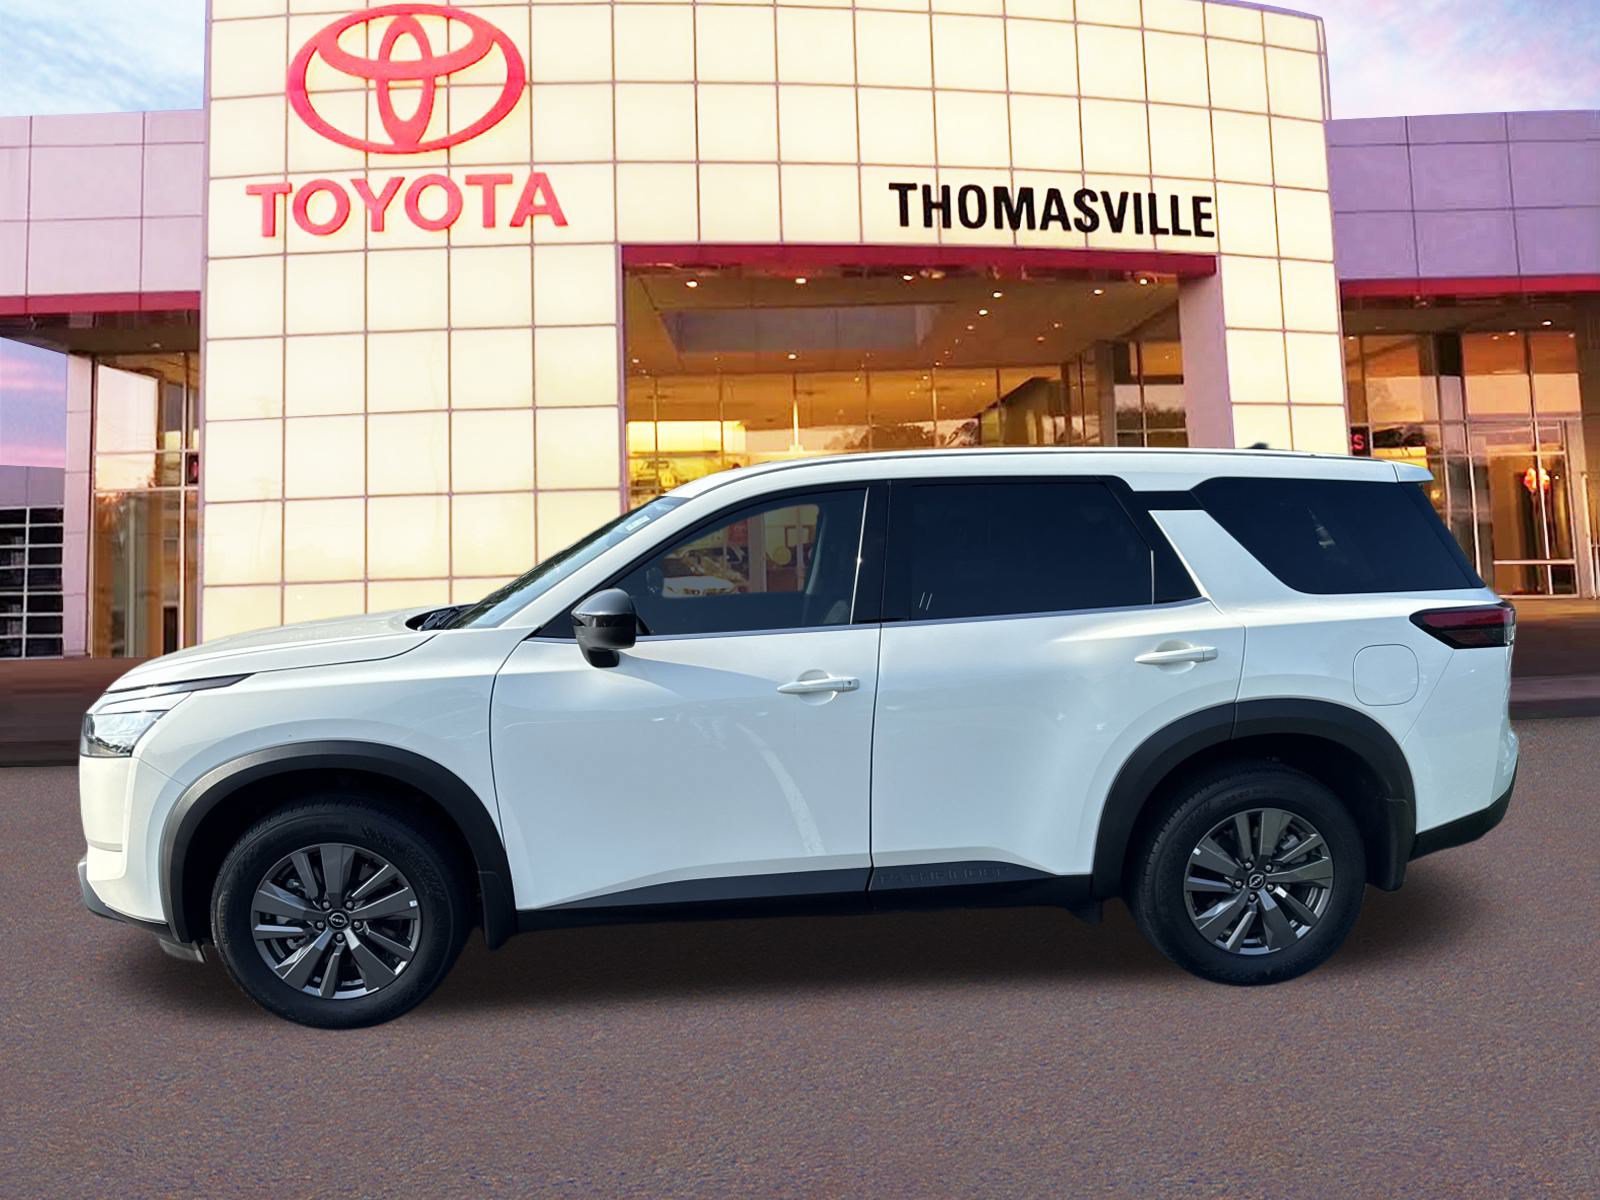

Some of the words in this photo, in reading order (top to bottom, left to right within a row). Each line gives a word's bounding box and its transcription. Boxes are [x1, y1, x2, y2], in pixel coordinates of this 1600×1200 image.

[246, 172, 569, 237] TOYOTA
[888, 183, 1215, 238] THOMASVILLE
[1350, 434, 1365, 450] S
